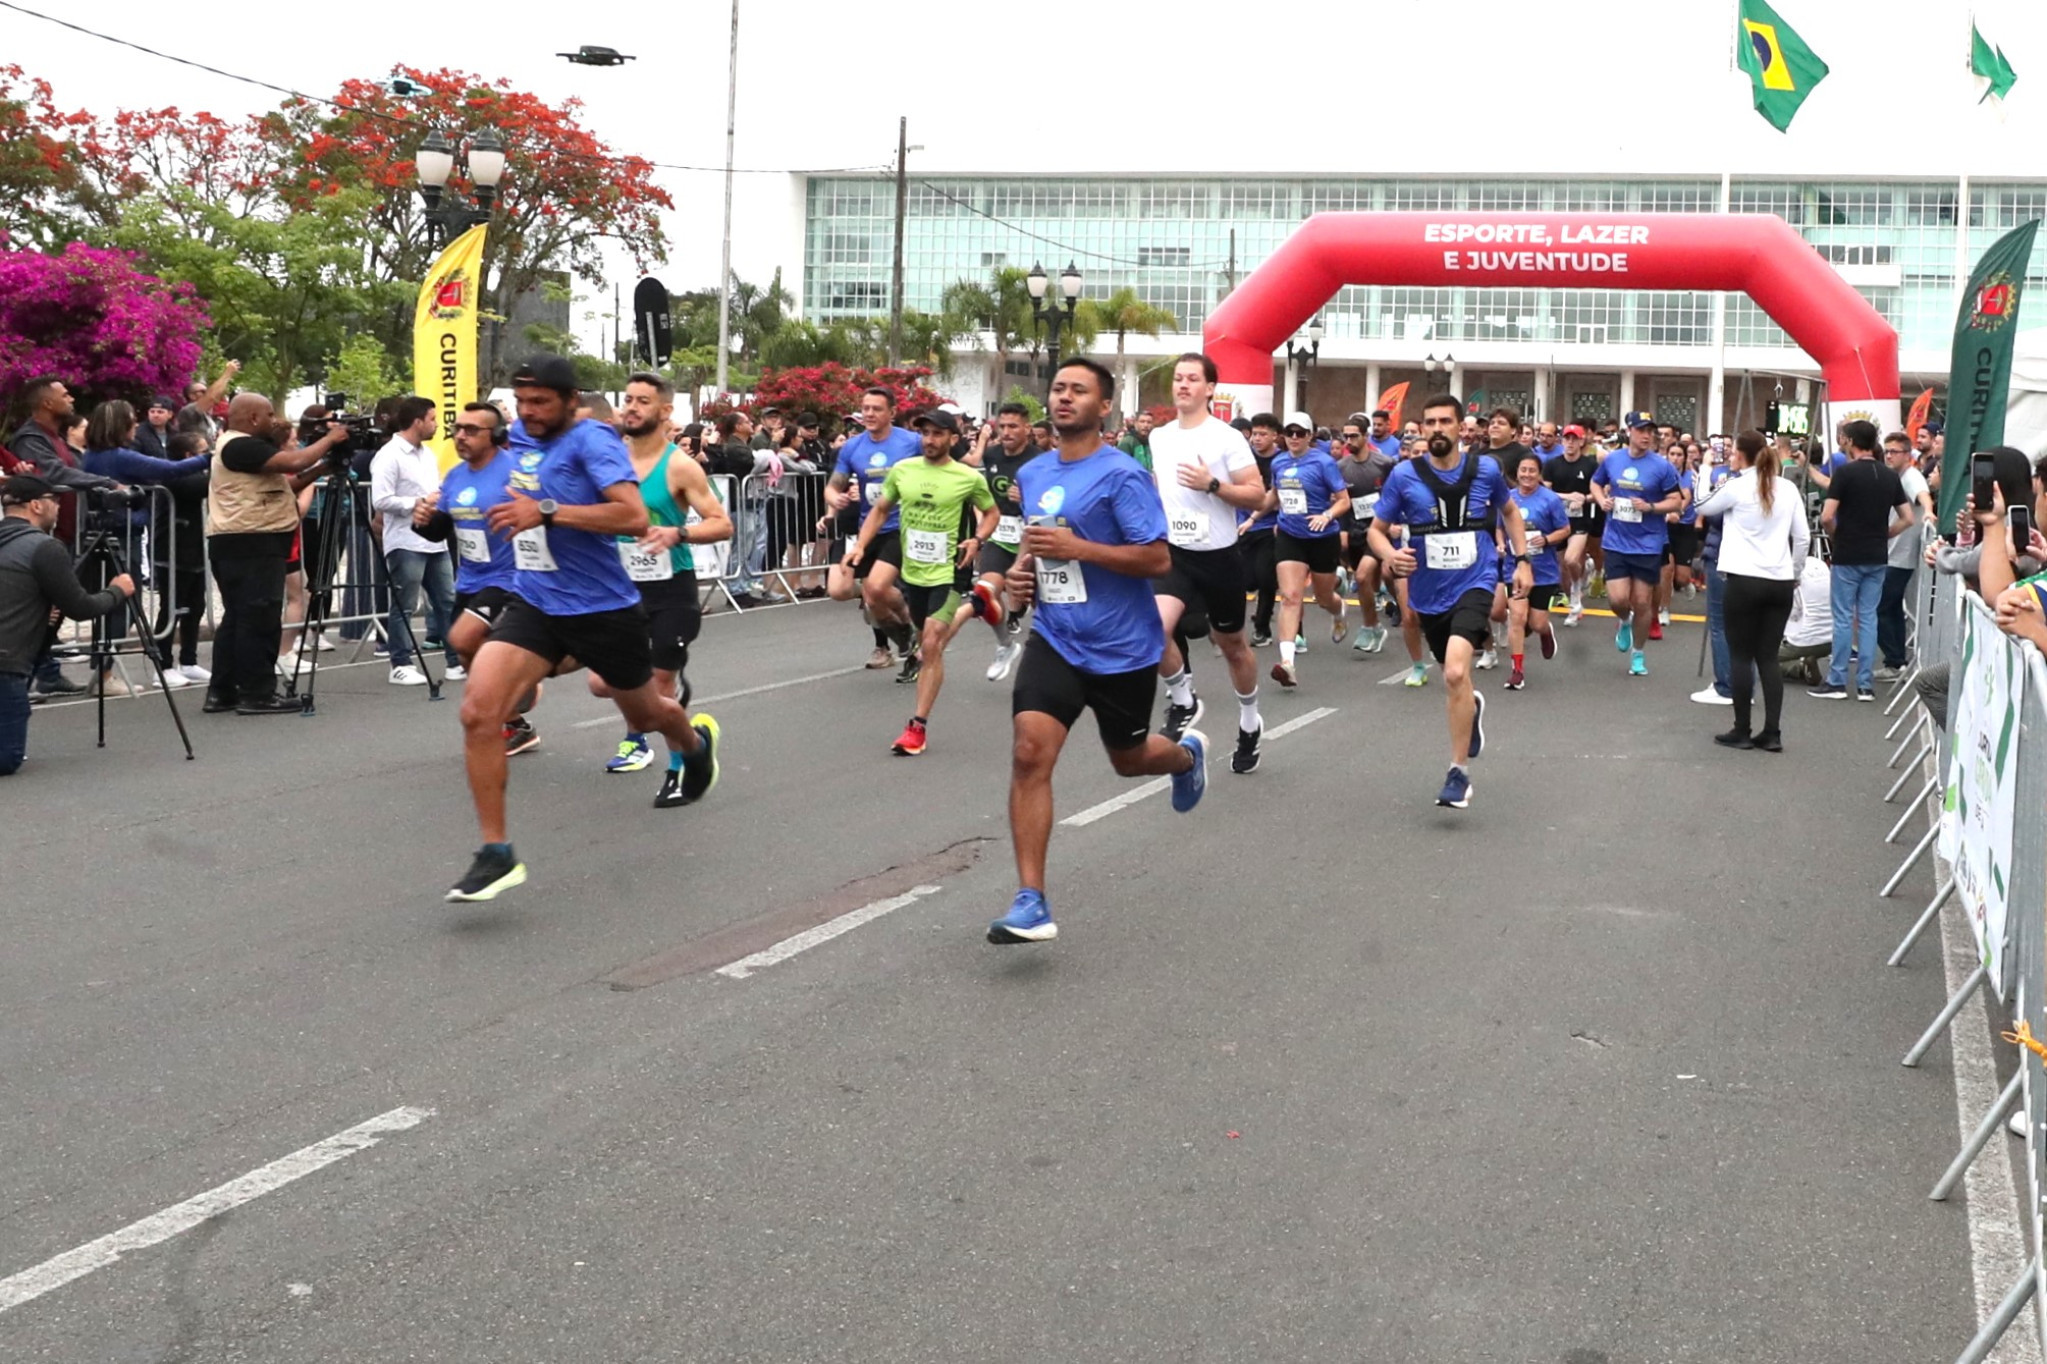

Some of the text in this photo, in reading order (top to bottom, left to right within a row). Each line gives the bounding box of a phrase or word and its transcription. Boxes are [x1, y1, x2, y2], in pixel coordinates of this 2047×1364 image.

[1424, 223, 1650, 247] ESPORTE, LAZER
[1443, 251, 1628, 272] E JUVENTUDE
[439, 332, 458, 441] CURITIBA
[1172, 520, 1197, 531] 1090
[914, 540, 936, 551] 2913
[1442, 546, 1459, 556] 711
[1039, 571, 1069, 585] 1778
